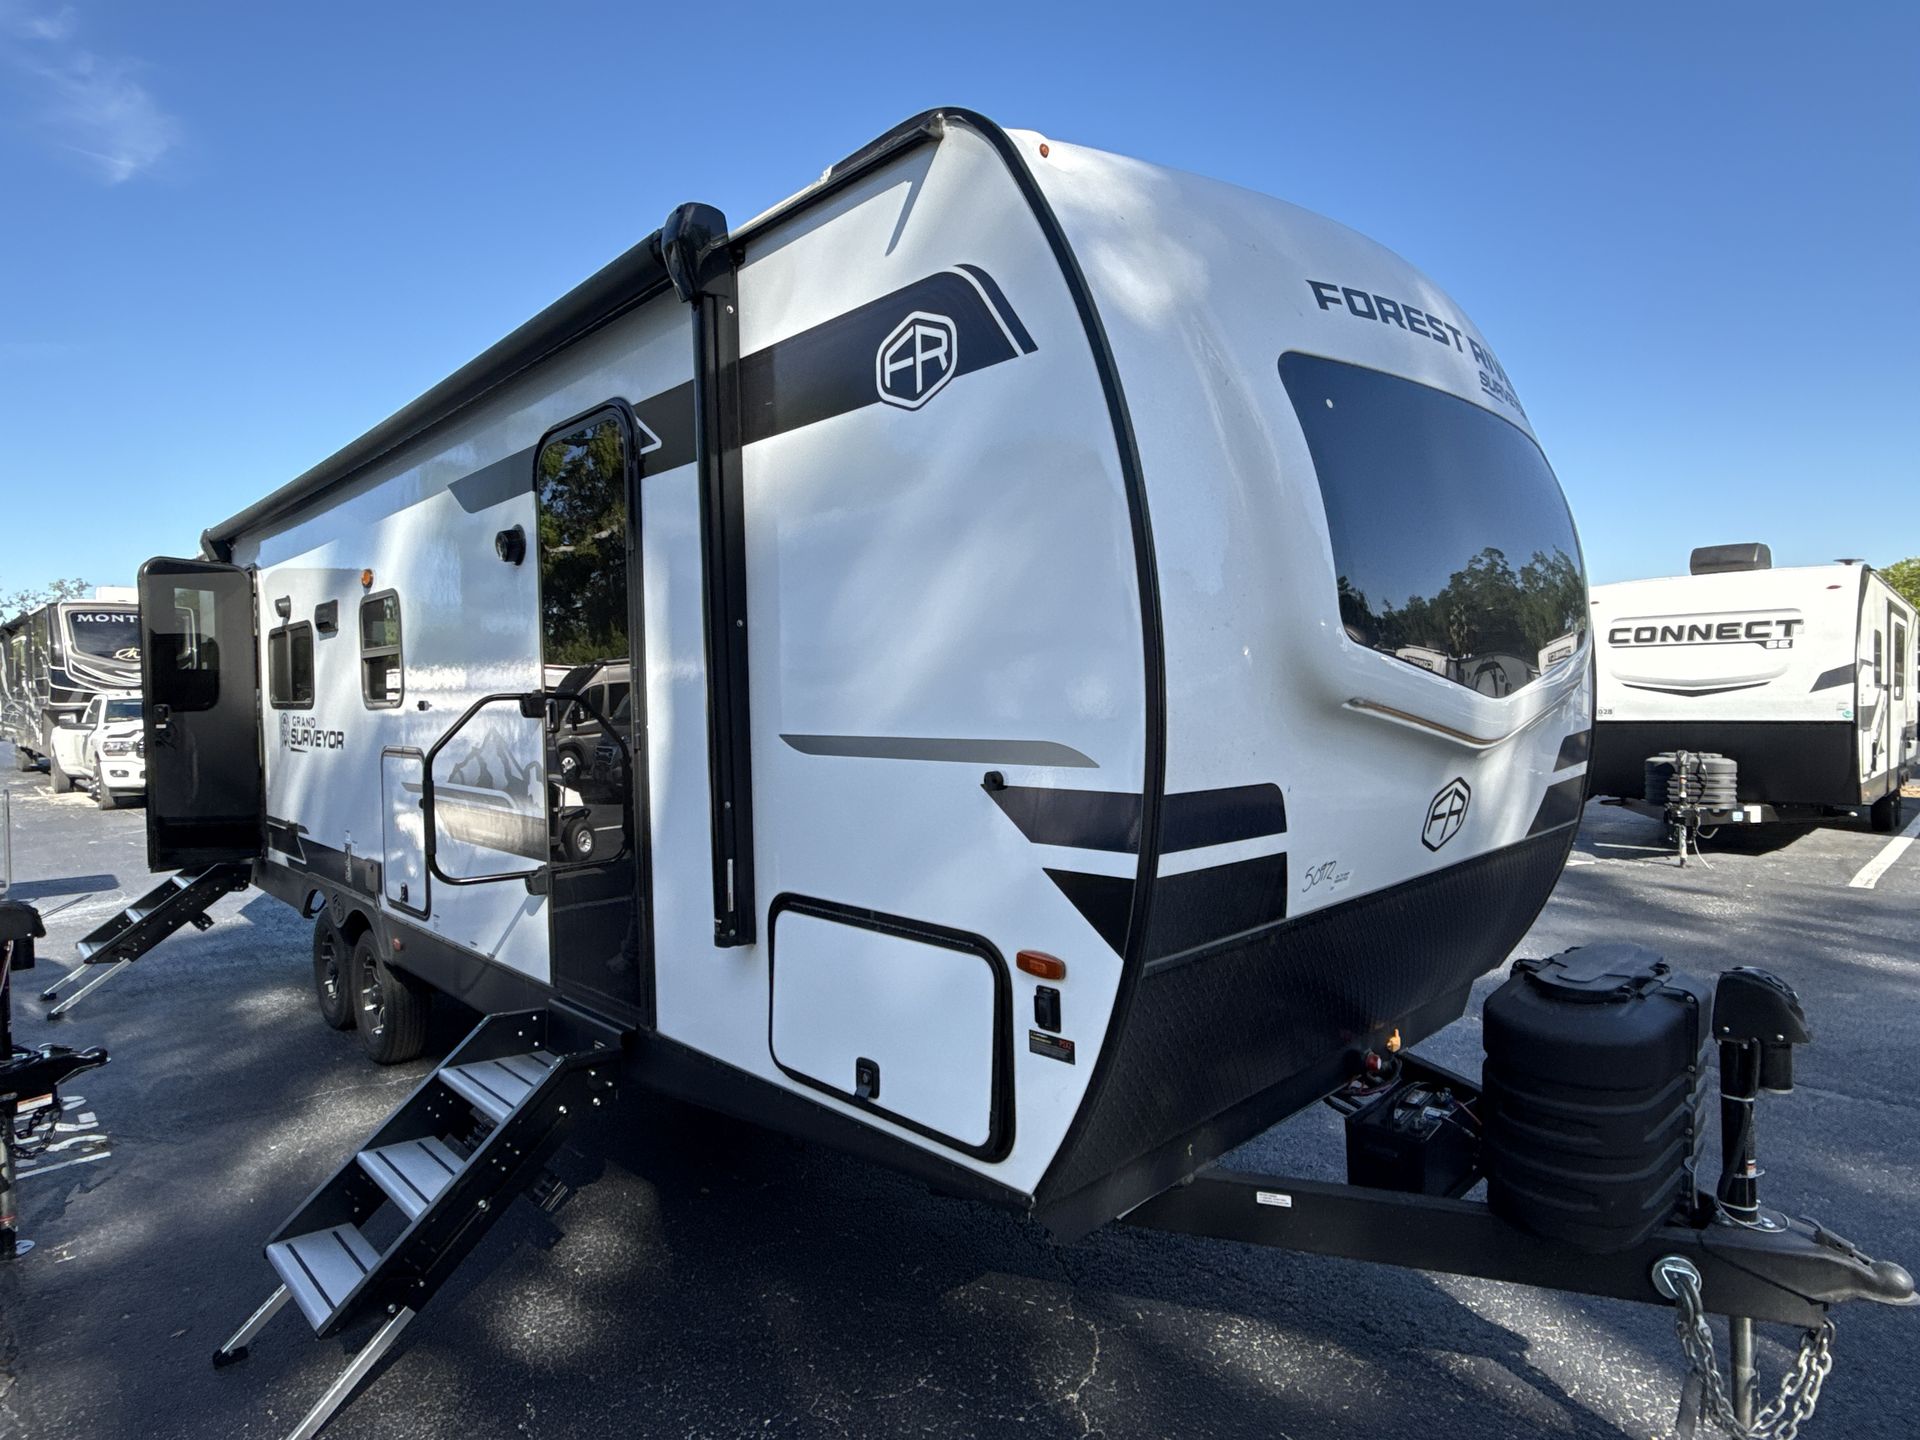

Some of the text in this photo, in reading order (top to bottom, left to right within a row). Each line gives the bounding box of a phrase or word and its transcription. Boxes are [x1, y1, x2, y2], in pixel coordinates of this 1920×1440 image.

[1305, 279, 1521, 402] FOREST RIV
[1608, 619, 1804, 644] CONNECT
[292, 716, 316, 728] GRAND
[291, 728, 345, 749] SURVEYOR
